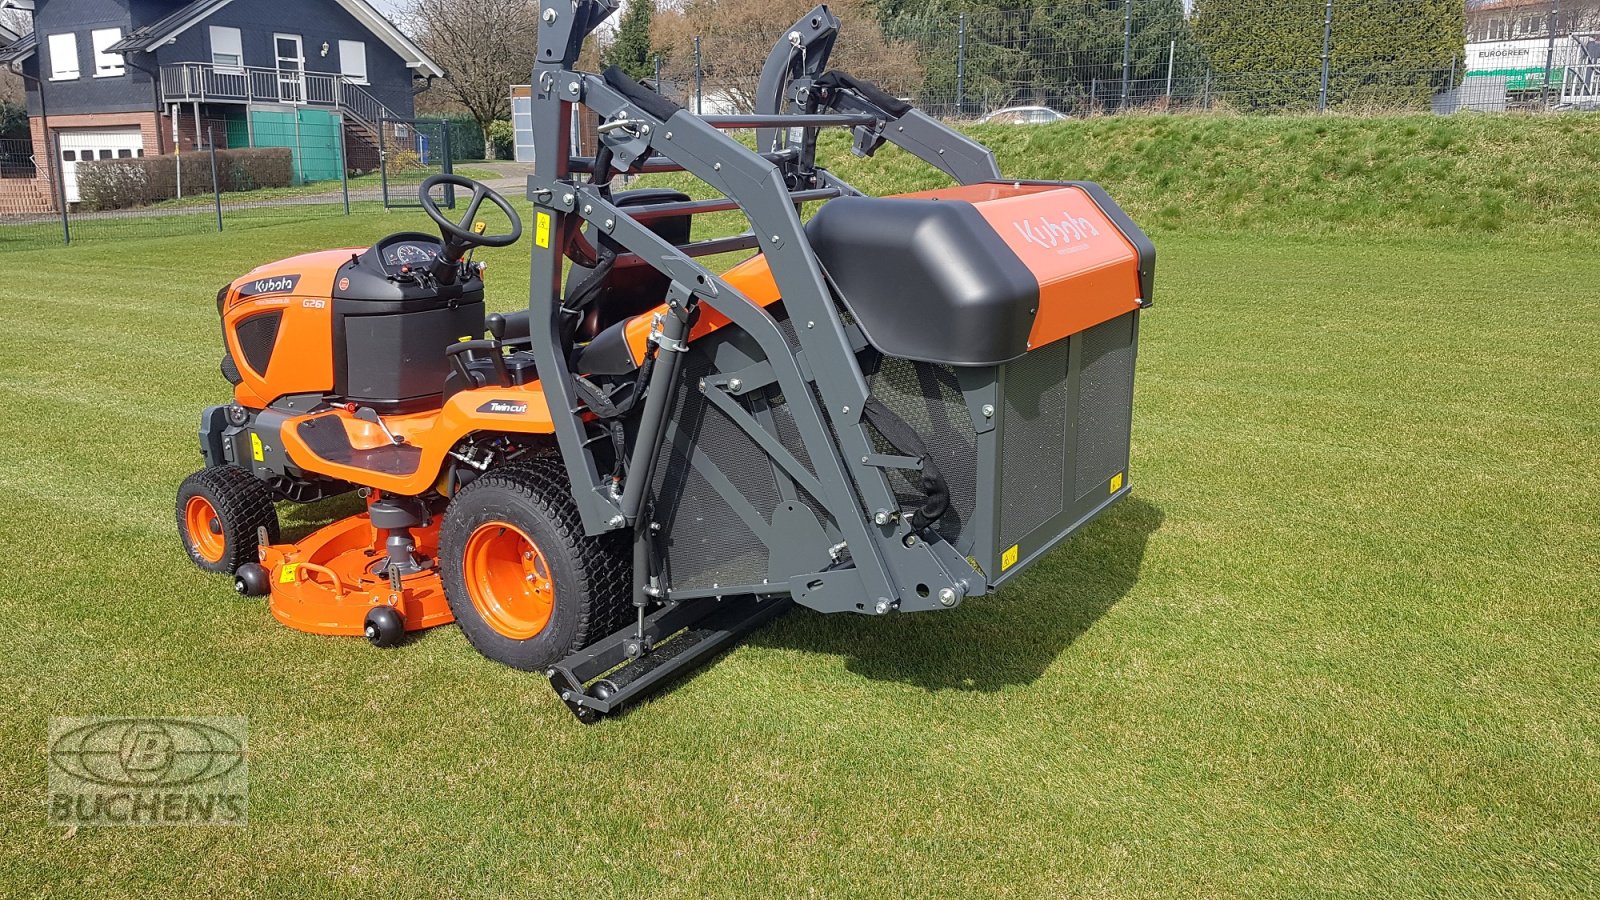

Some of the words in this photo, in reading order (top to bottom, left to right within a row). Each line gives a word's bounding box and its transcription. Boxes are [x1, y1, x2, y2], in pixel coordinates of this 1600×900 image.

[1478, 49, 1530, 58] EUROGREEN
[1013, 211, 1100, 249] Kubota
[255, 277, 292, 293] Kubota
[302, 299, 326, 309] G261
